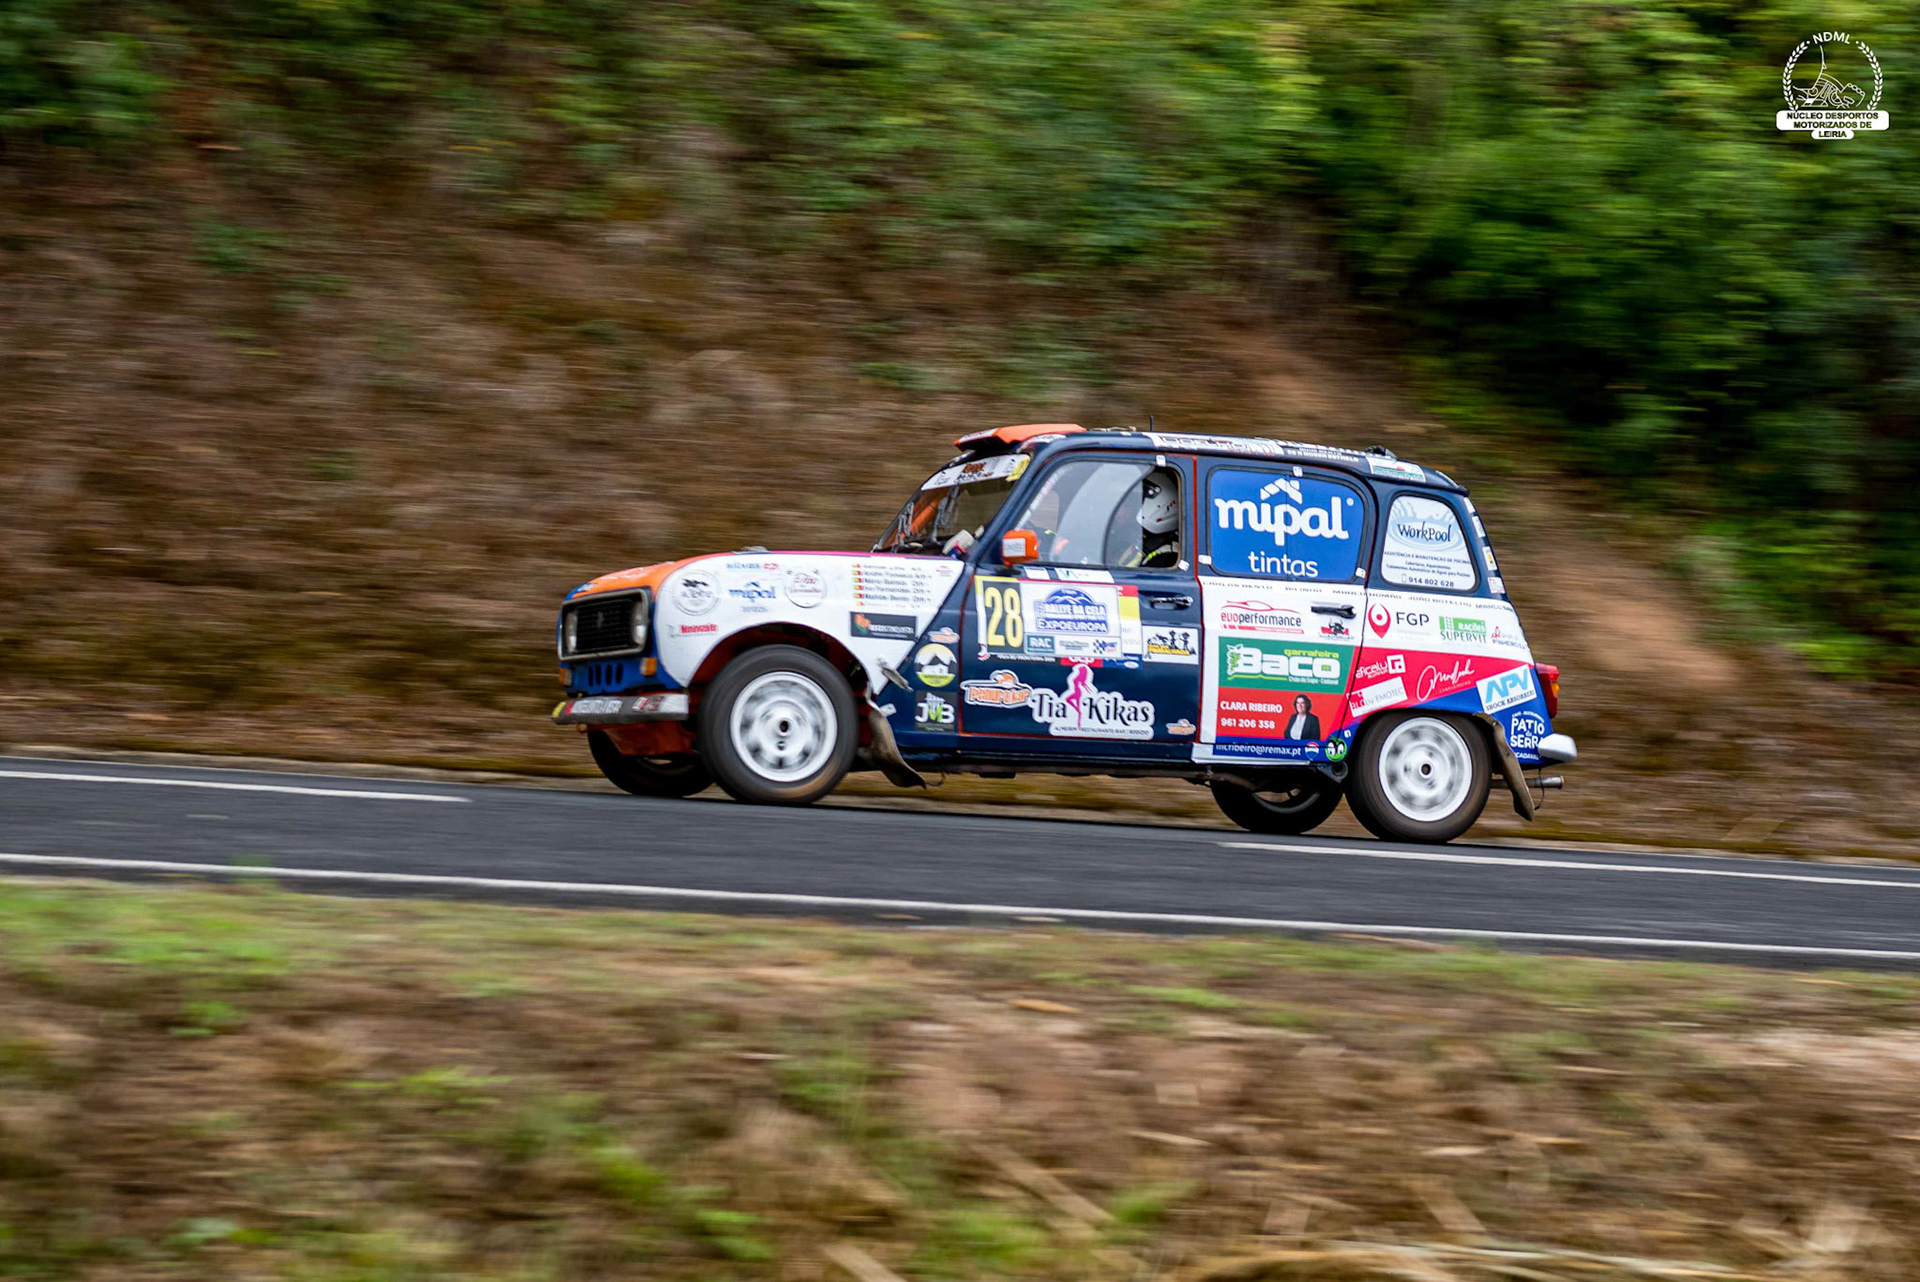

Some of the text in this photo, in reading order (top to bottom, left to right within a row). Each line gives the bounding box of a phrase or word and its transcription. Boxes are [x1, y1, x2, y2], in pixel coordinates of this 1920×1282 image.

[1214, 495, 1349, 546] mipal
[1397, 521, 1452, 542] WorkPool
[1248, 551, 1319, 577] tintas
[984, 586, 1024, 648] 28
[1085, 605, 1106, 616] CELA
[1037, 620, 1108, 633] EXPOEUROPA
[1396, 611, 1429, 627] FGP
[1458, 621, 1485, 633] RAÇÕES
[1029, 637, 1052, 648] RAC
[1440, 630, 1487, 643] SUPERVIT
[1284, 648, 1339, 658] garrafeira
[1227, 644, 1340, 679] Baco
[1485, 668, 1528, 703] APV
[1375, 687, 1404, 703] EMOTEC
[1032, 693, 1067, 718] Tia
[1082, 696, 1150, 726] Kikas
[1220, 701, 1283, 713] CLARA RIBEIRO
[1485, 699, 1506, 711] SHOCK
[1220, 717, 1275, 729] 961 206 358
[1510, 734, 1543, 749] SERR
